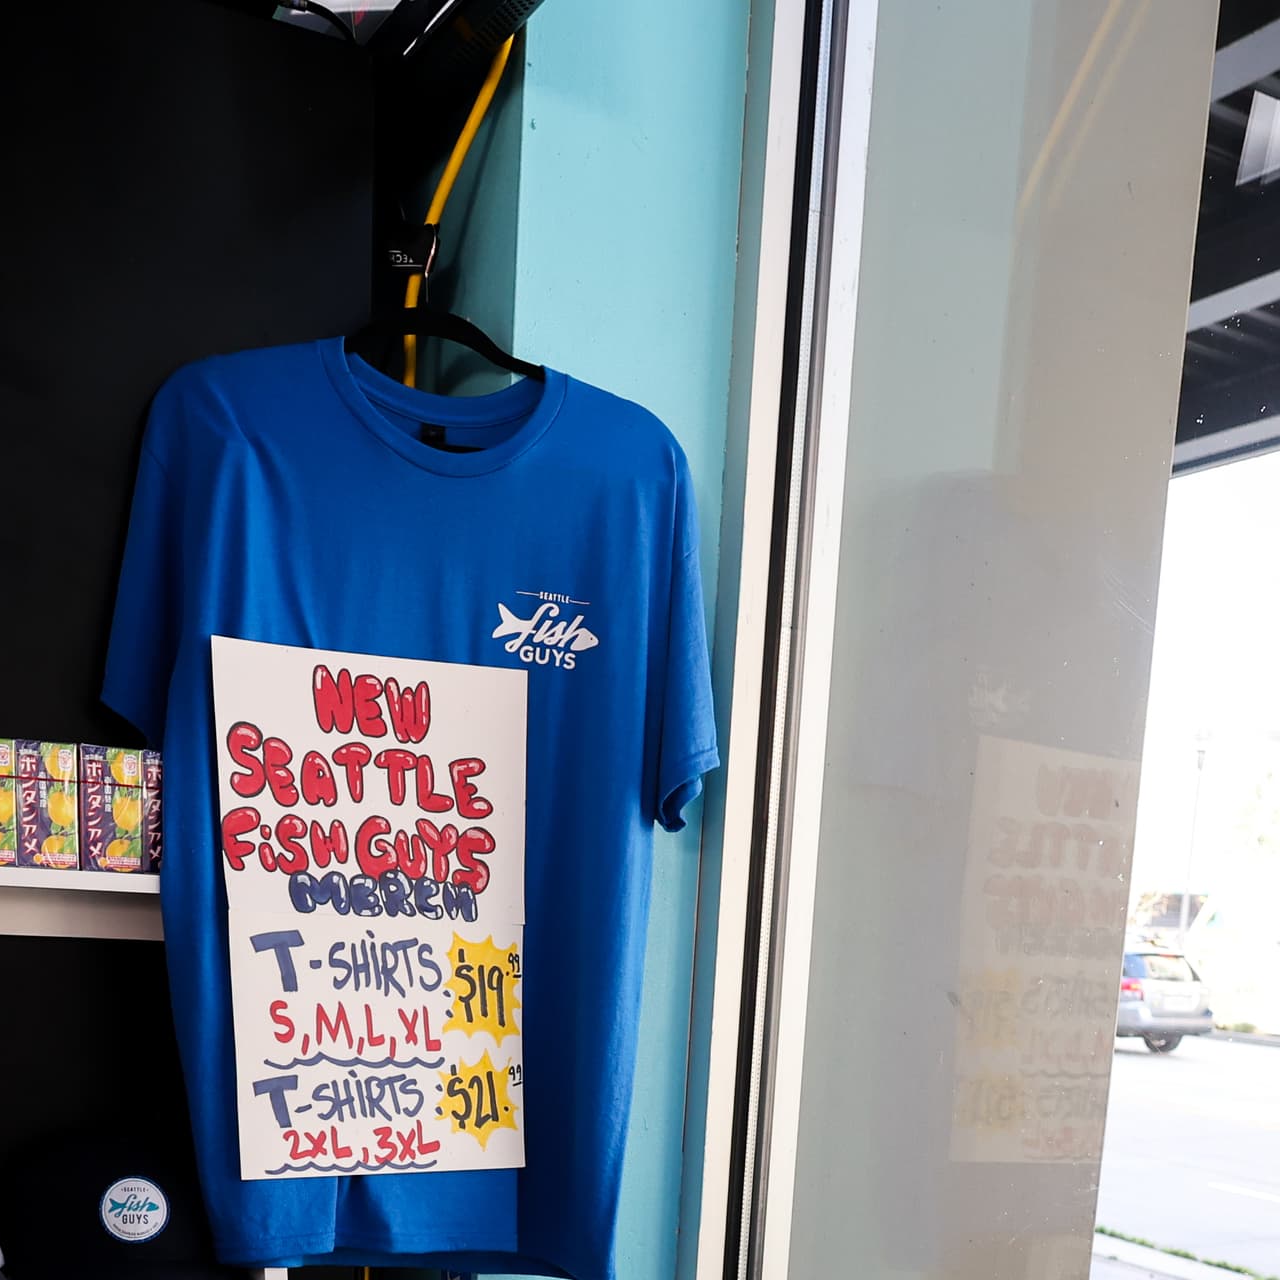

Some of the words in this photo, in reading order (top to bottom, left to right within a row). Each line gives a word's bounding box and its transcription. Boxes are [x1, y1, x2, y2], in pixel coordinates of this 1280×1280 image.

[540, 591, 570, 604] SEATTLE
[501, 603, 592, 653] fish
[519, 645, 576, 670] GUYS
[313, 665, 431, 744] NEW
[226, 721, 494, 819] SEATTLE
[19, 756, 38, 854] ボンタンアメ
[86, 761, 104, 858] ボンタンアメ
[354, 815, 496, 895] GUYS
[288, 870, 479, 923] MERCH
[112, 1193, 154, 1218] fish
[121, 1213, 149, 1225] GUYS
